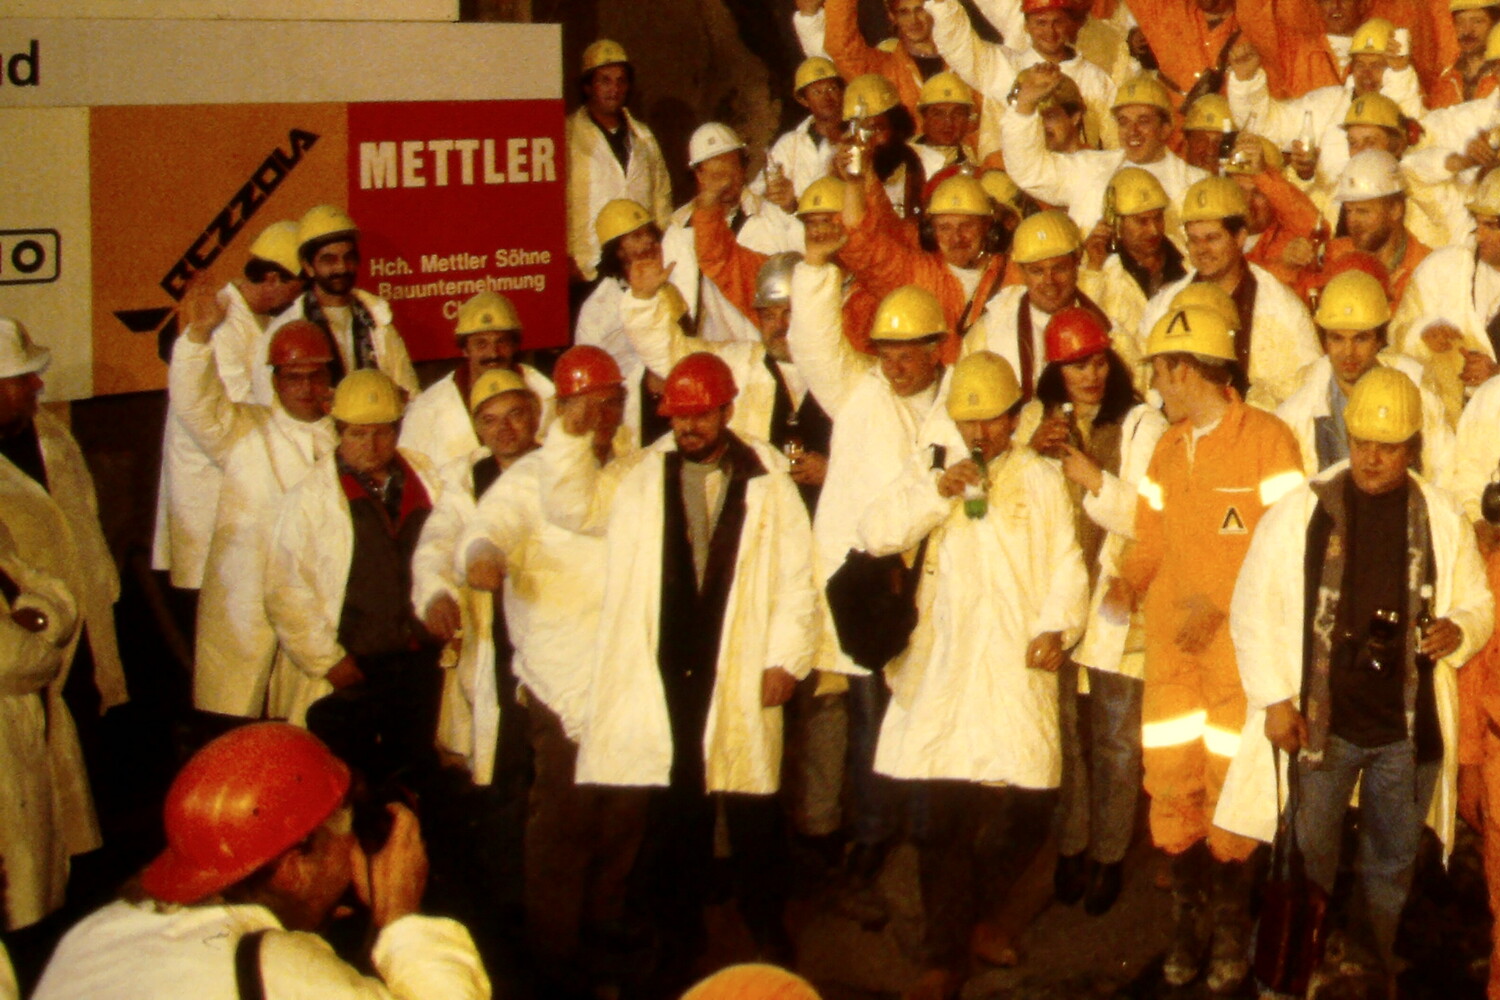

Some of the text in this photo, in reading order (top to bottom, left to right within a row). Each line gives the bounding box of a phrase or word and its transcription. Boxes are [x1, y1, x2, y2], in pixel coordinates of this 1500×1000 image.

[360, 137, 556, 189] METTLER
[369, 248, 550, 276] Hch. Mettler Söhne
[378, 273, 545, 299] Bauunternehmung
